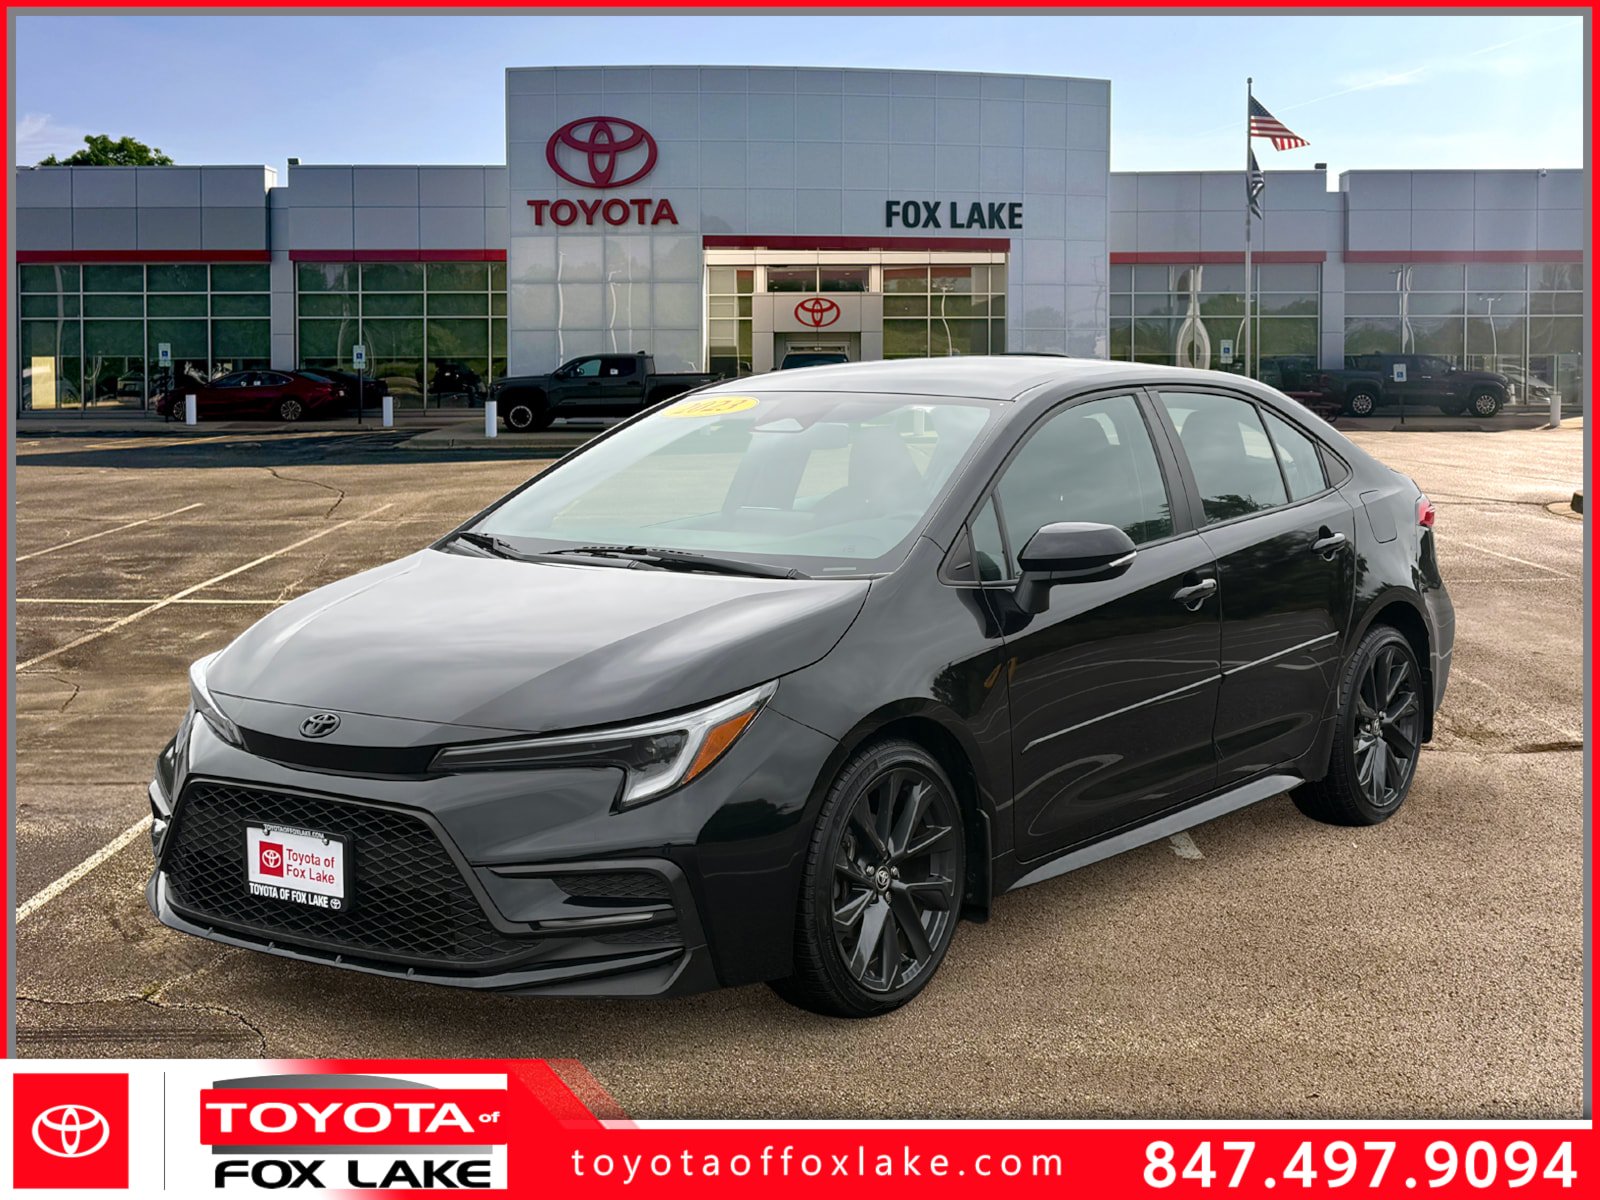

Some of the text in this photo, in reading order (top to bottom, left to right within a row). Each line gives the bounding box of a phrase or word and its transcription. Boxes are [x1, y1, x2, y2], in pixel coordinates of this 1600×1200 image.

[527, 199, 678, 226] TOYOTA
[885, 201, 1023, 229] FOX LAKE
[286, 848, 335, 868] Toyota of
[286, 864, 335, 884] Fox Lake
[249, 883, 329, 908] TOYOTA OF FOX LAKE
